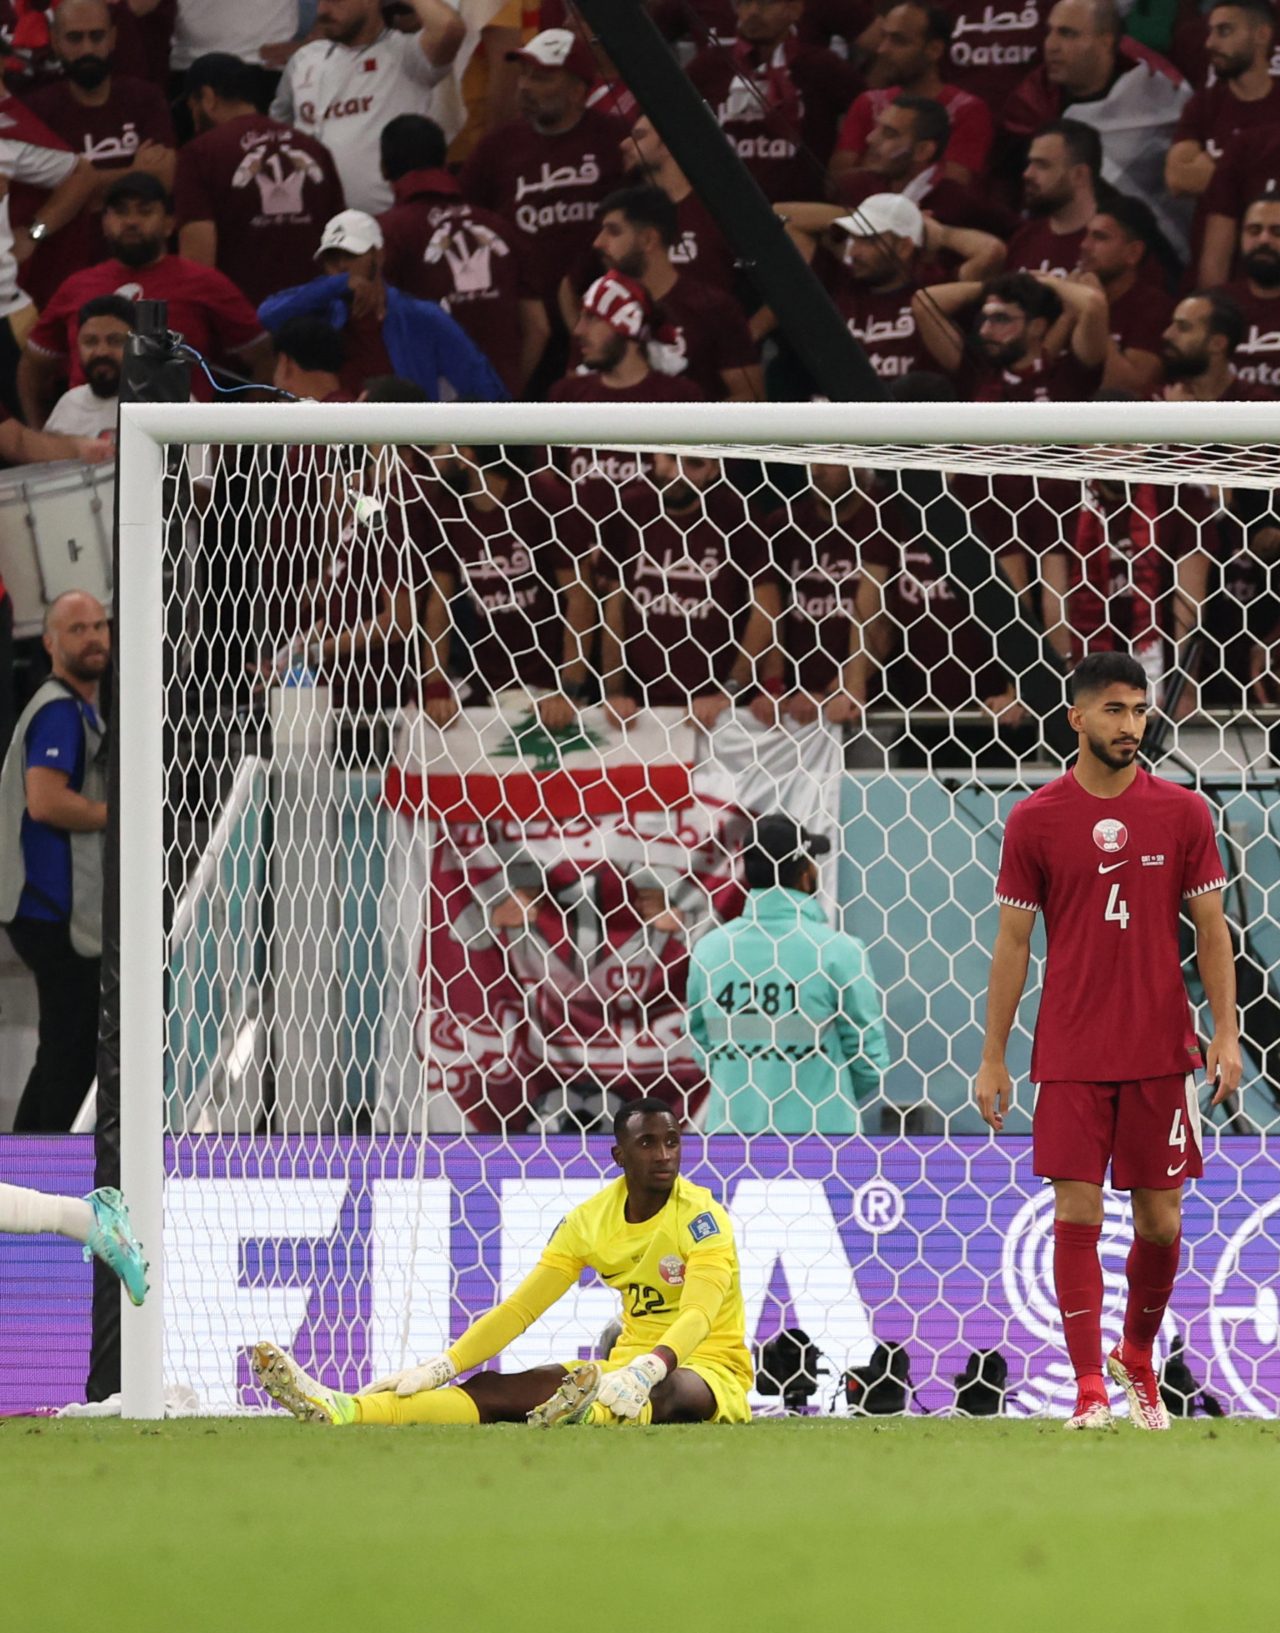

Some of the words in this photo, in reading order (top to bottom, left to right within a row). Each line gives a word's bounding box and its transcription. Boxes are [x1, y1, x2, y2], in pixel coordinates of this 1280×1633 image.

[949, 42, 1037, 66] Qatar
[300, 95, 374, 125] Qtar
[514, 153, 600, 202] قطر
[515, 200, 600, 234] Qatar
[868, 352, 914, 376] tar
[1104, 883, 1130, 929] 4
[716, 981, 799, 1016] 4281
[1168, 1108, 1187, 1154] 4
[628, 1283, 672, 1318] 22
